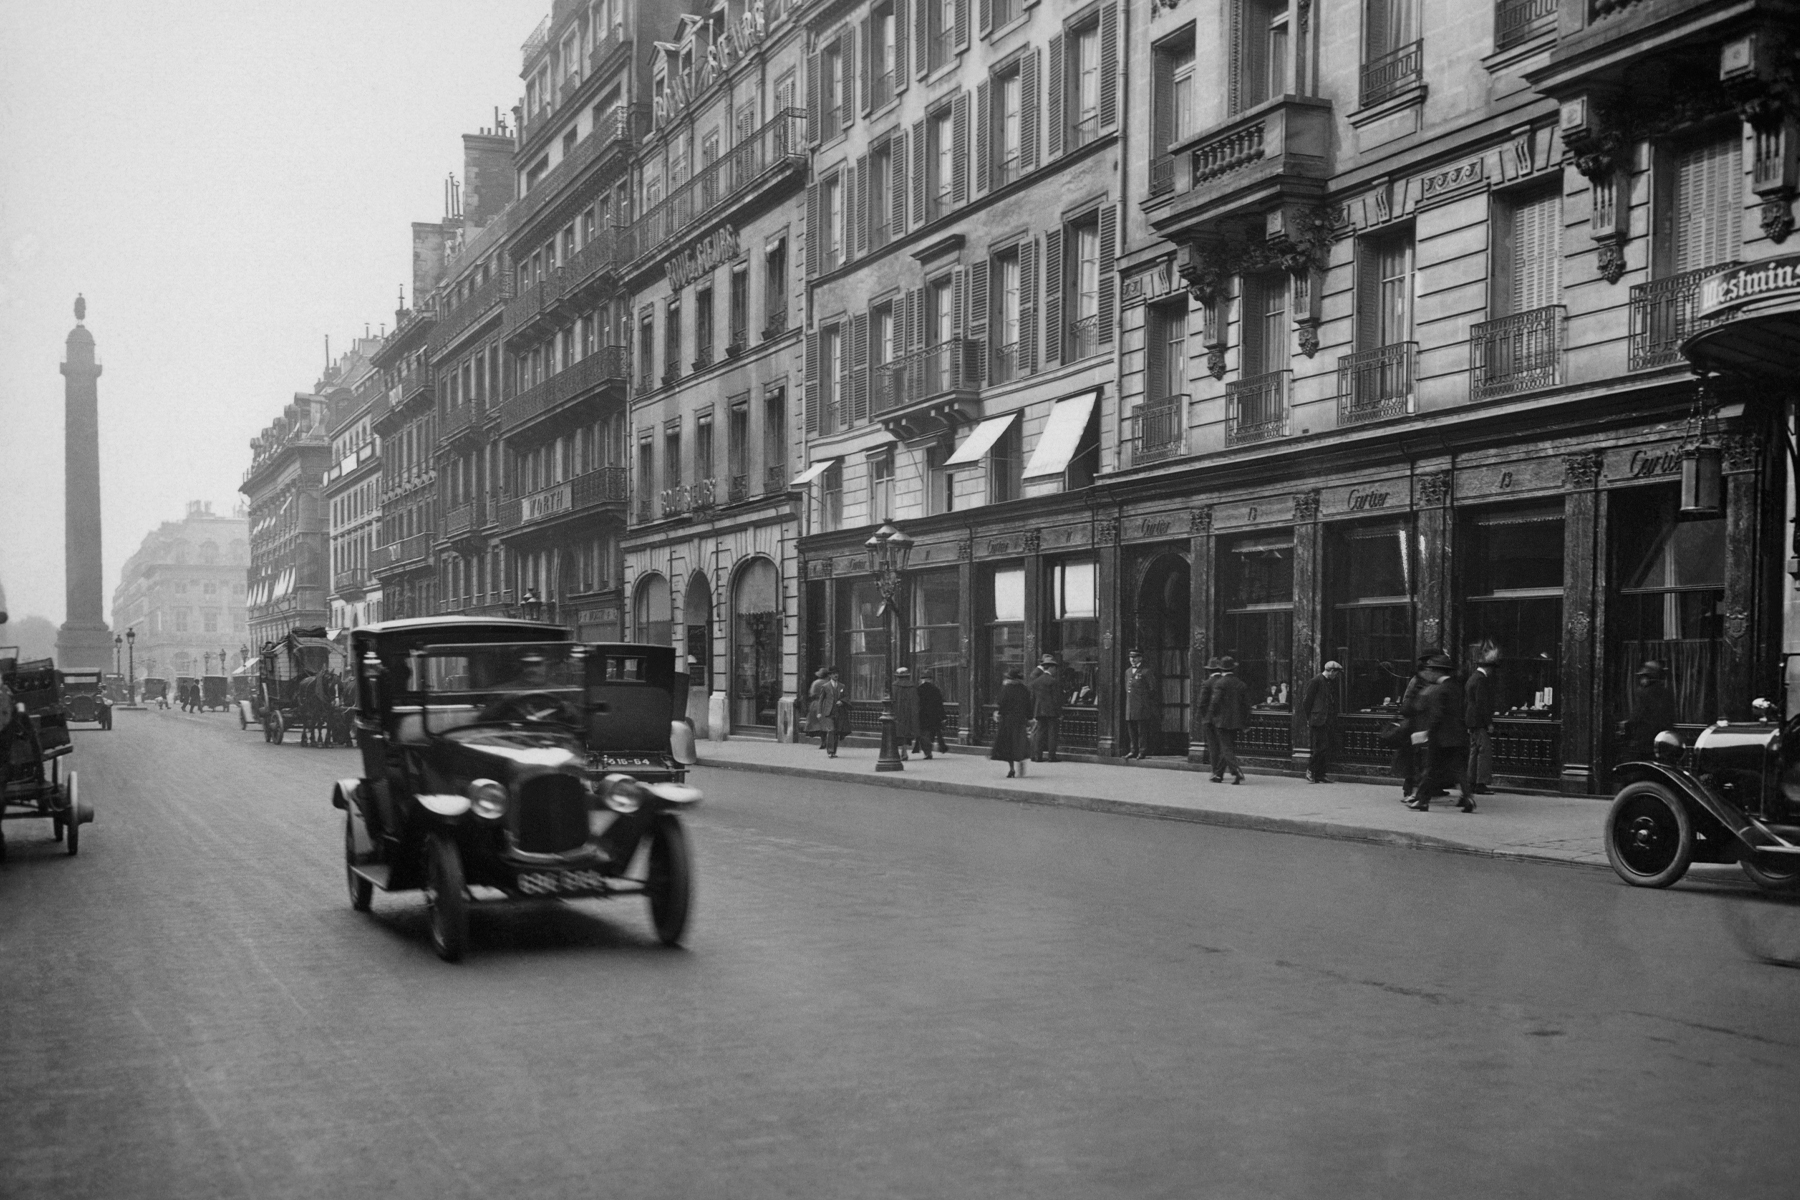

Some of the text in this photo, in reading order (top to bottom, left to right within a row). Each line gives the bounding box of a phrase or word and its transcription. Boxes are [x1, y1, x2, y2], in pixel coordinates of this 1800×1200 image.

[1500, 471, 1513, 488] 13
[1347, 489, 1390, 510] Cartier
[1141, 518, 1171, 536] Cartier
